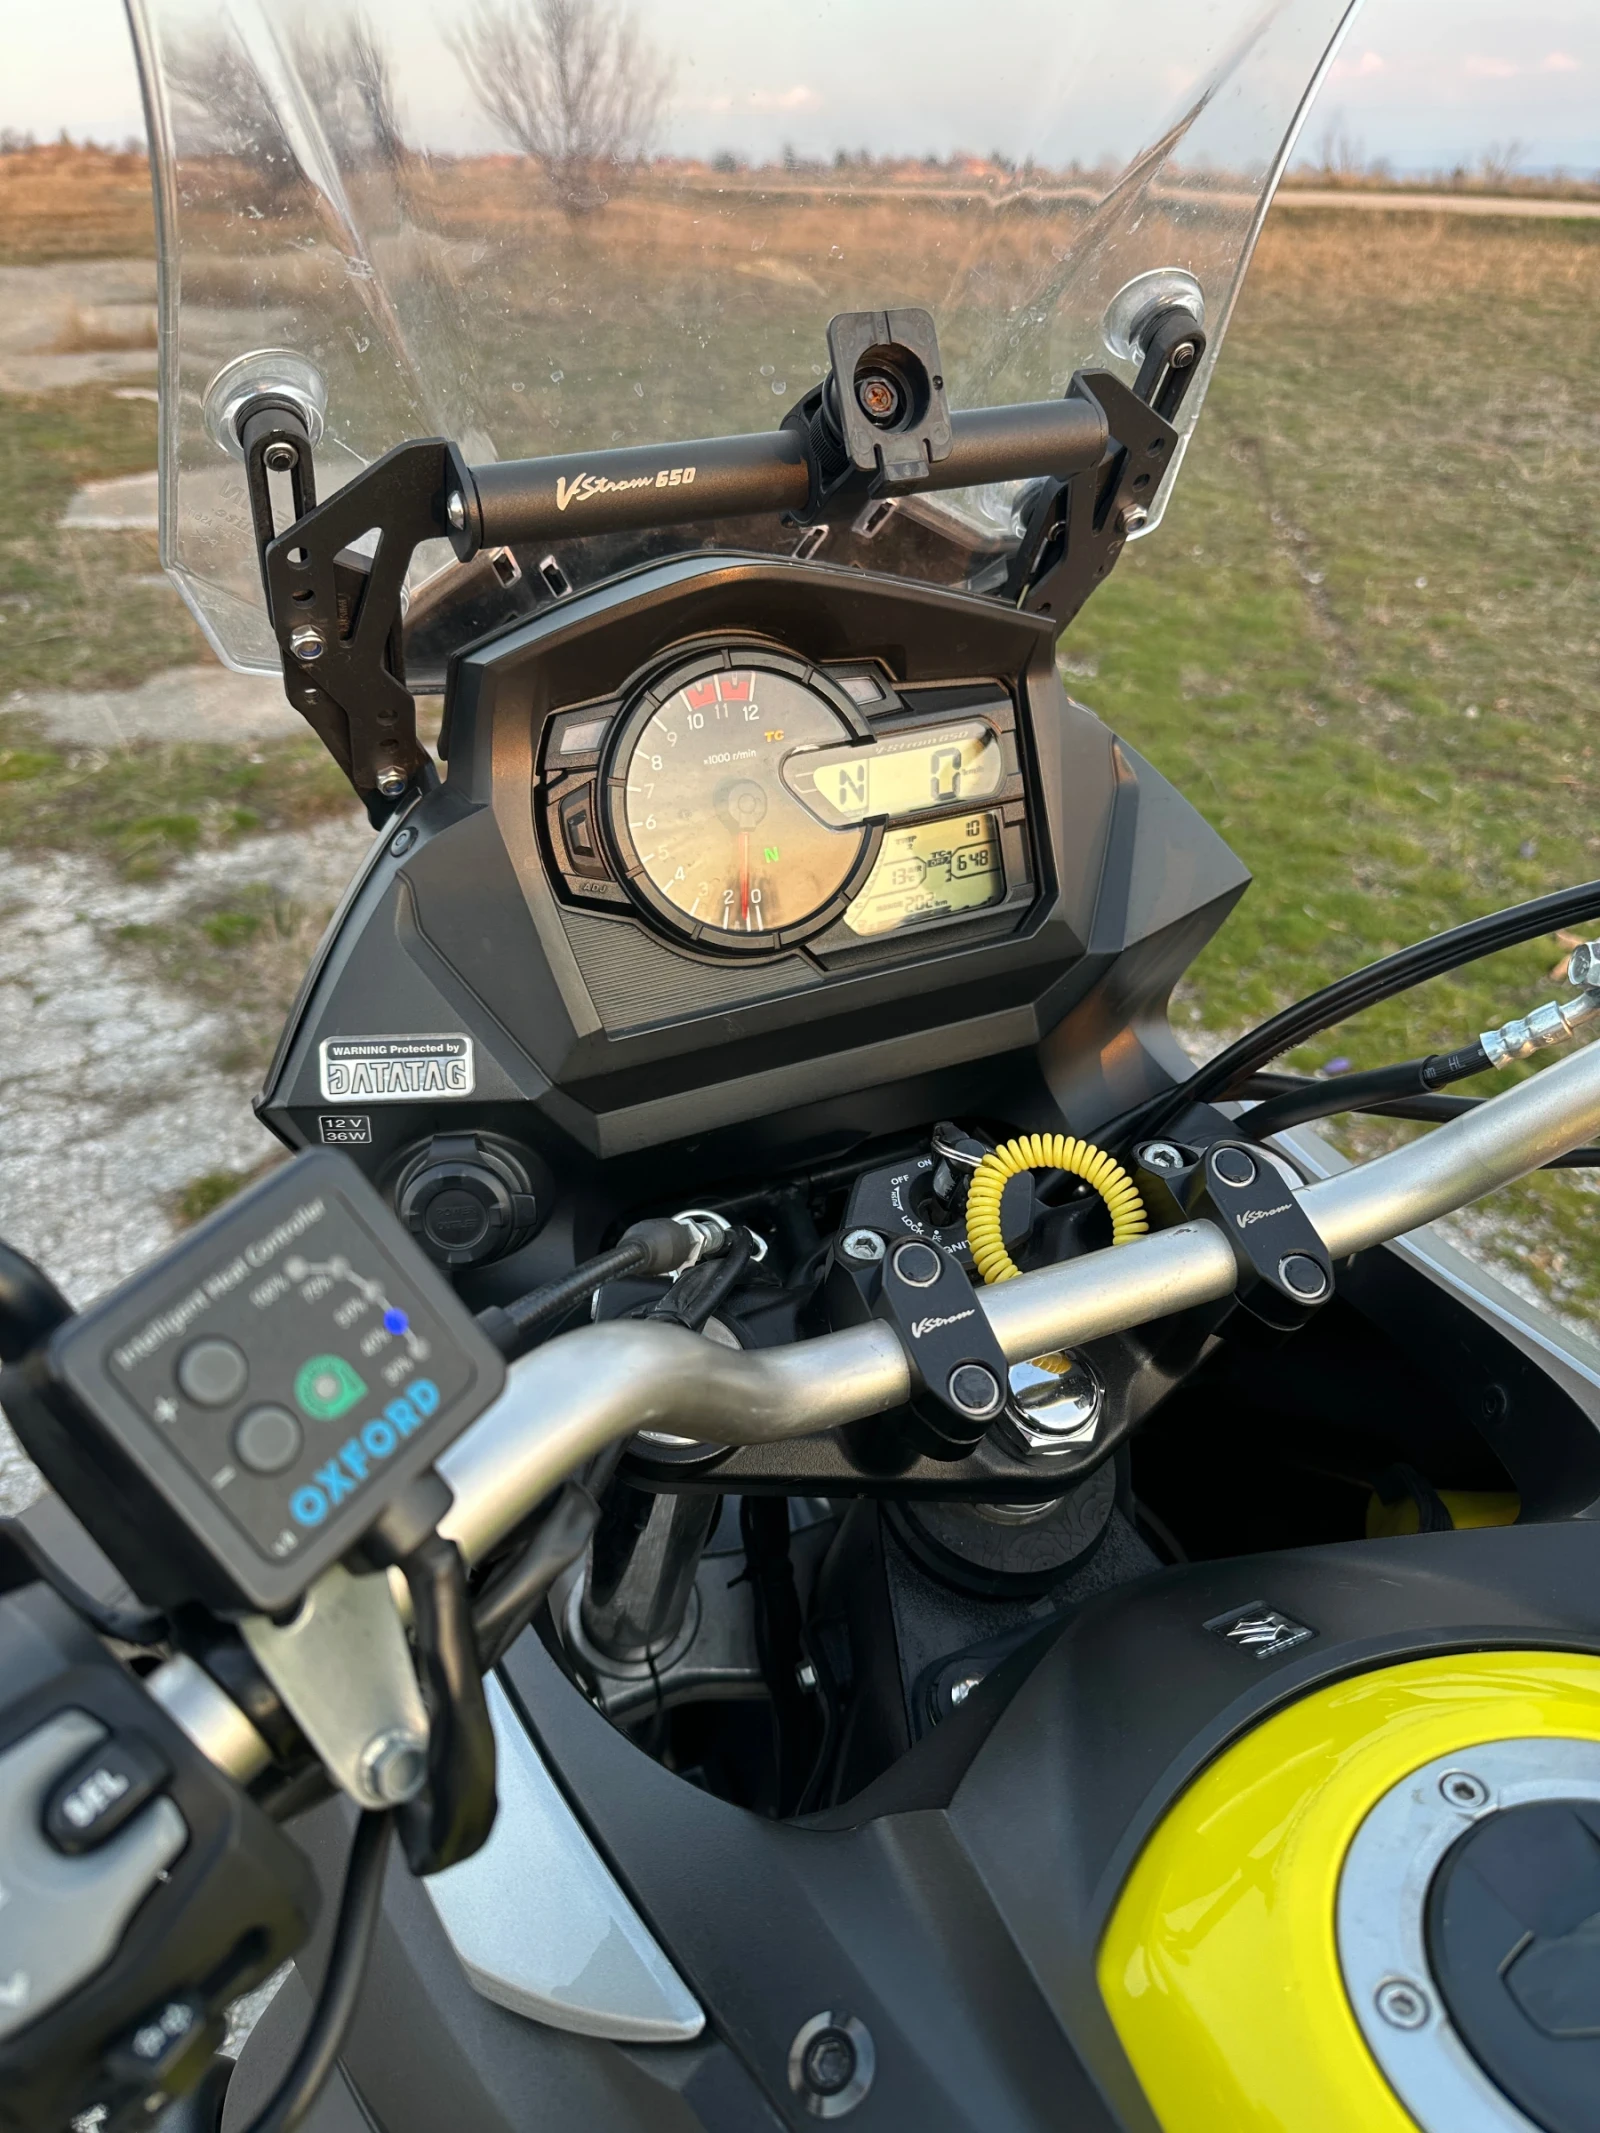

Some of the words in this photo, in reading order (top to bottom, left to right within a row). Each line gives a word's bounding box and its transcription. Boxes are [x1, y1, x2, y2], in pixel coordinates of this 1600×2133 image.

[655, 467, 696, 488] 650
[714, 703, 729, 719] 11
[742, 704, 760, 721] 12
[687, 713, 704, 730] 10
[666, 731, 678, 747] 9
[764, 729, 785, 743] TC
[732, 749, 757, 760] r/min
[651, 755, 663, 771] 8
[930, 747, 962, 801] 0
[644, 783, 655, 799] 7
[839, 764, 865, 805] N
[645, 813, 657, 830] 6
[965, 820, 981, 837] 10
[658, 846, 670, 861] 5
[764, 846, 780, 864] N
[674, 866, 686, 881] 4
[583, 882, 608, 893] ADJ
[698, 882, 709, 897] 3
[723, 890, 735, 905] 2
[751, 888, 762, 904] 0
[333, 1045, 387, 1056] WARNING
[390, 1043, 446, 1055] Protected
[447, 1043, 460, 1054] by
[326, 1119, 346, 1128] 12
[350, 1119, 362, 1128] V
[917, 1158, 932, 1168] ON
[890, 1174, 910, 1185] OFF
[901, 1215, 925, 1235] LOCK
[289, 1378, 440, 1526] OXFORD
